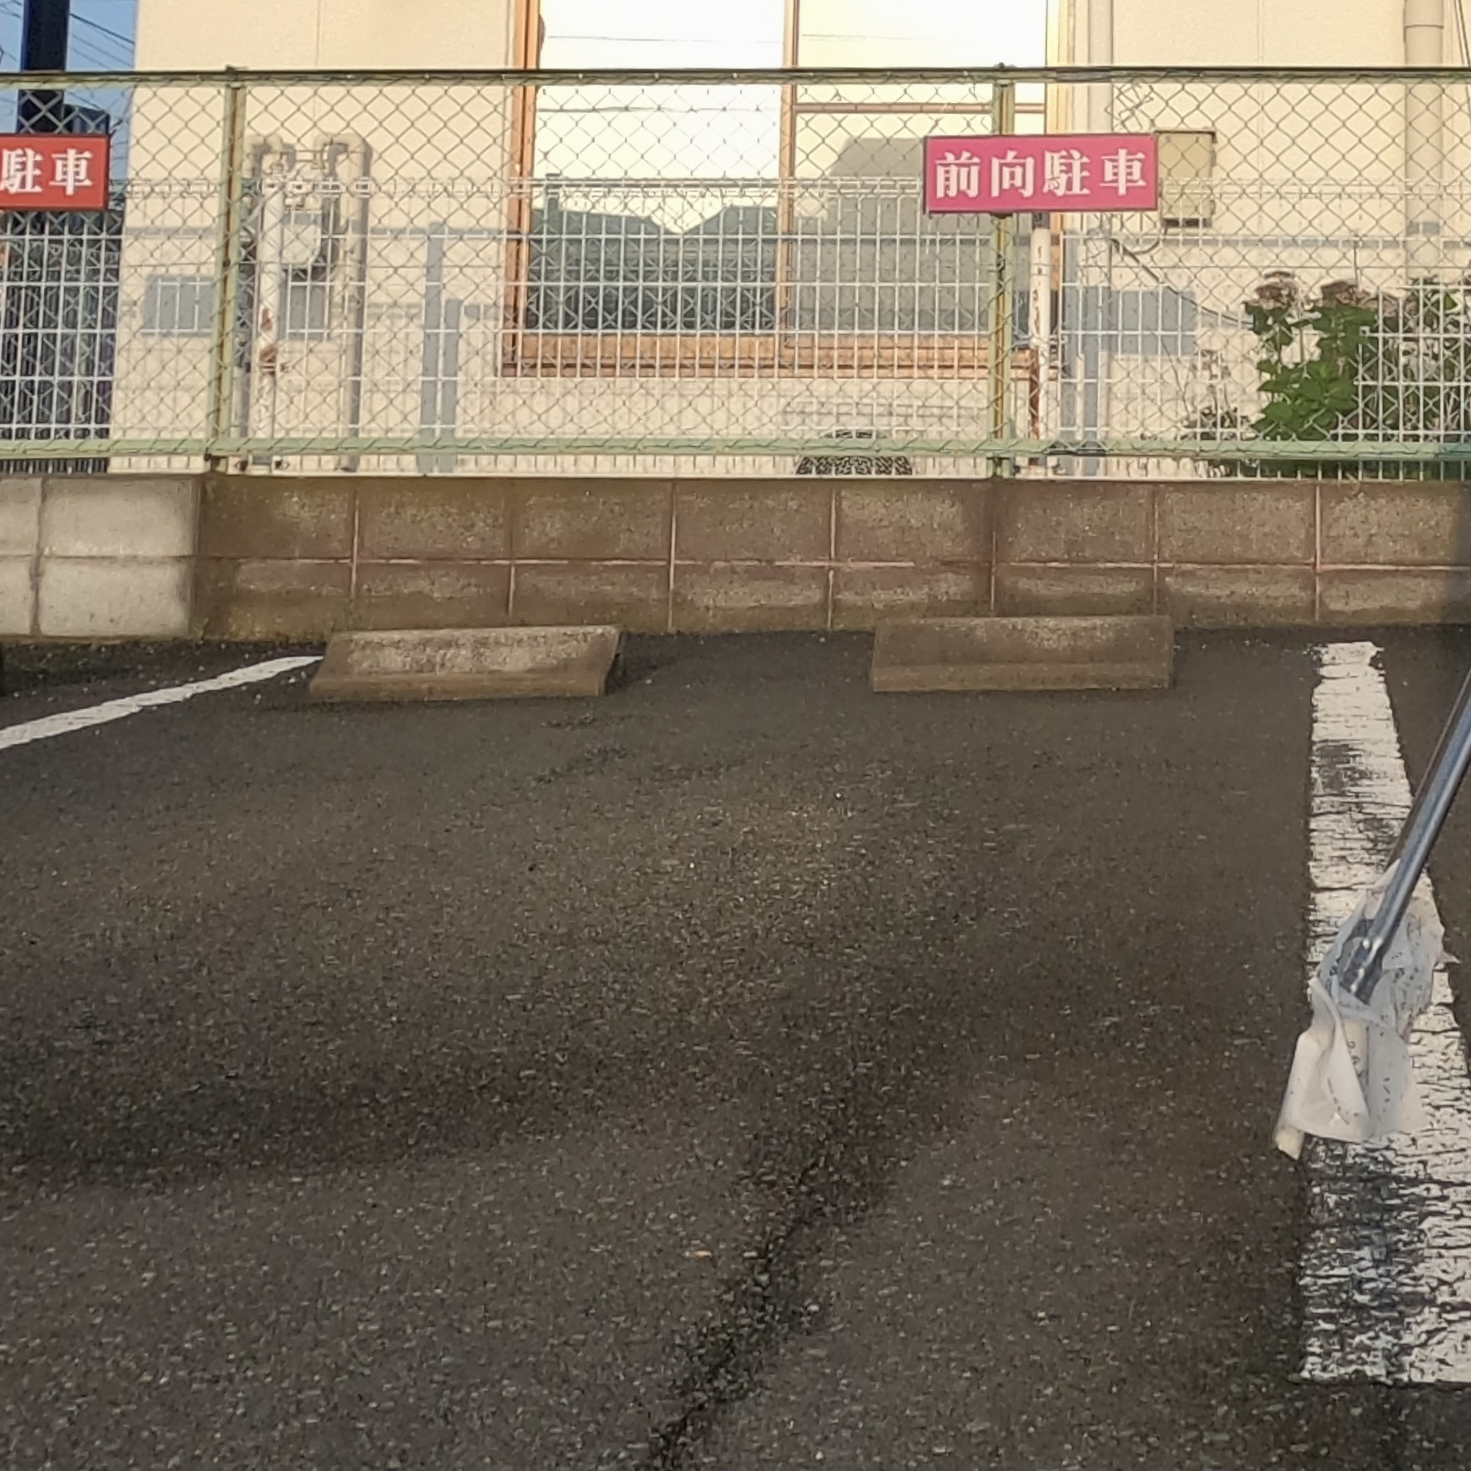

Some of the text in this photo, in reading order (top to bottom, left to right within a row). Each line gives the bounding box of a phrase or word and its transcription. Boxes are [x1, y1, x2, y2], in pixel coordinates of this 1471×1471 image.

[0, 147, 94, 197] 駐車
[935, 148, 1148, 200] 前向駐車
